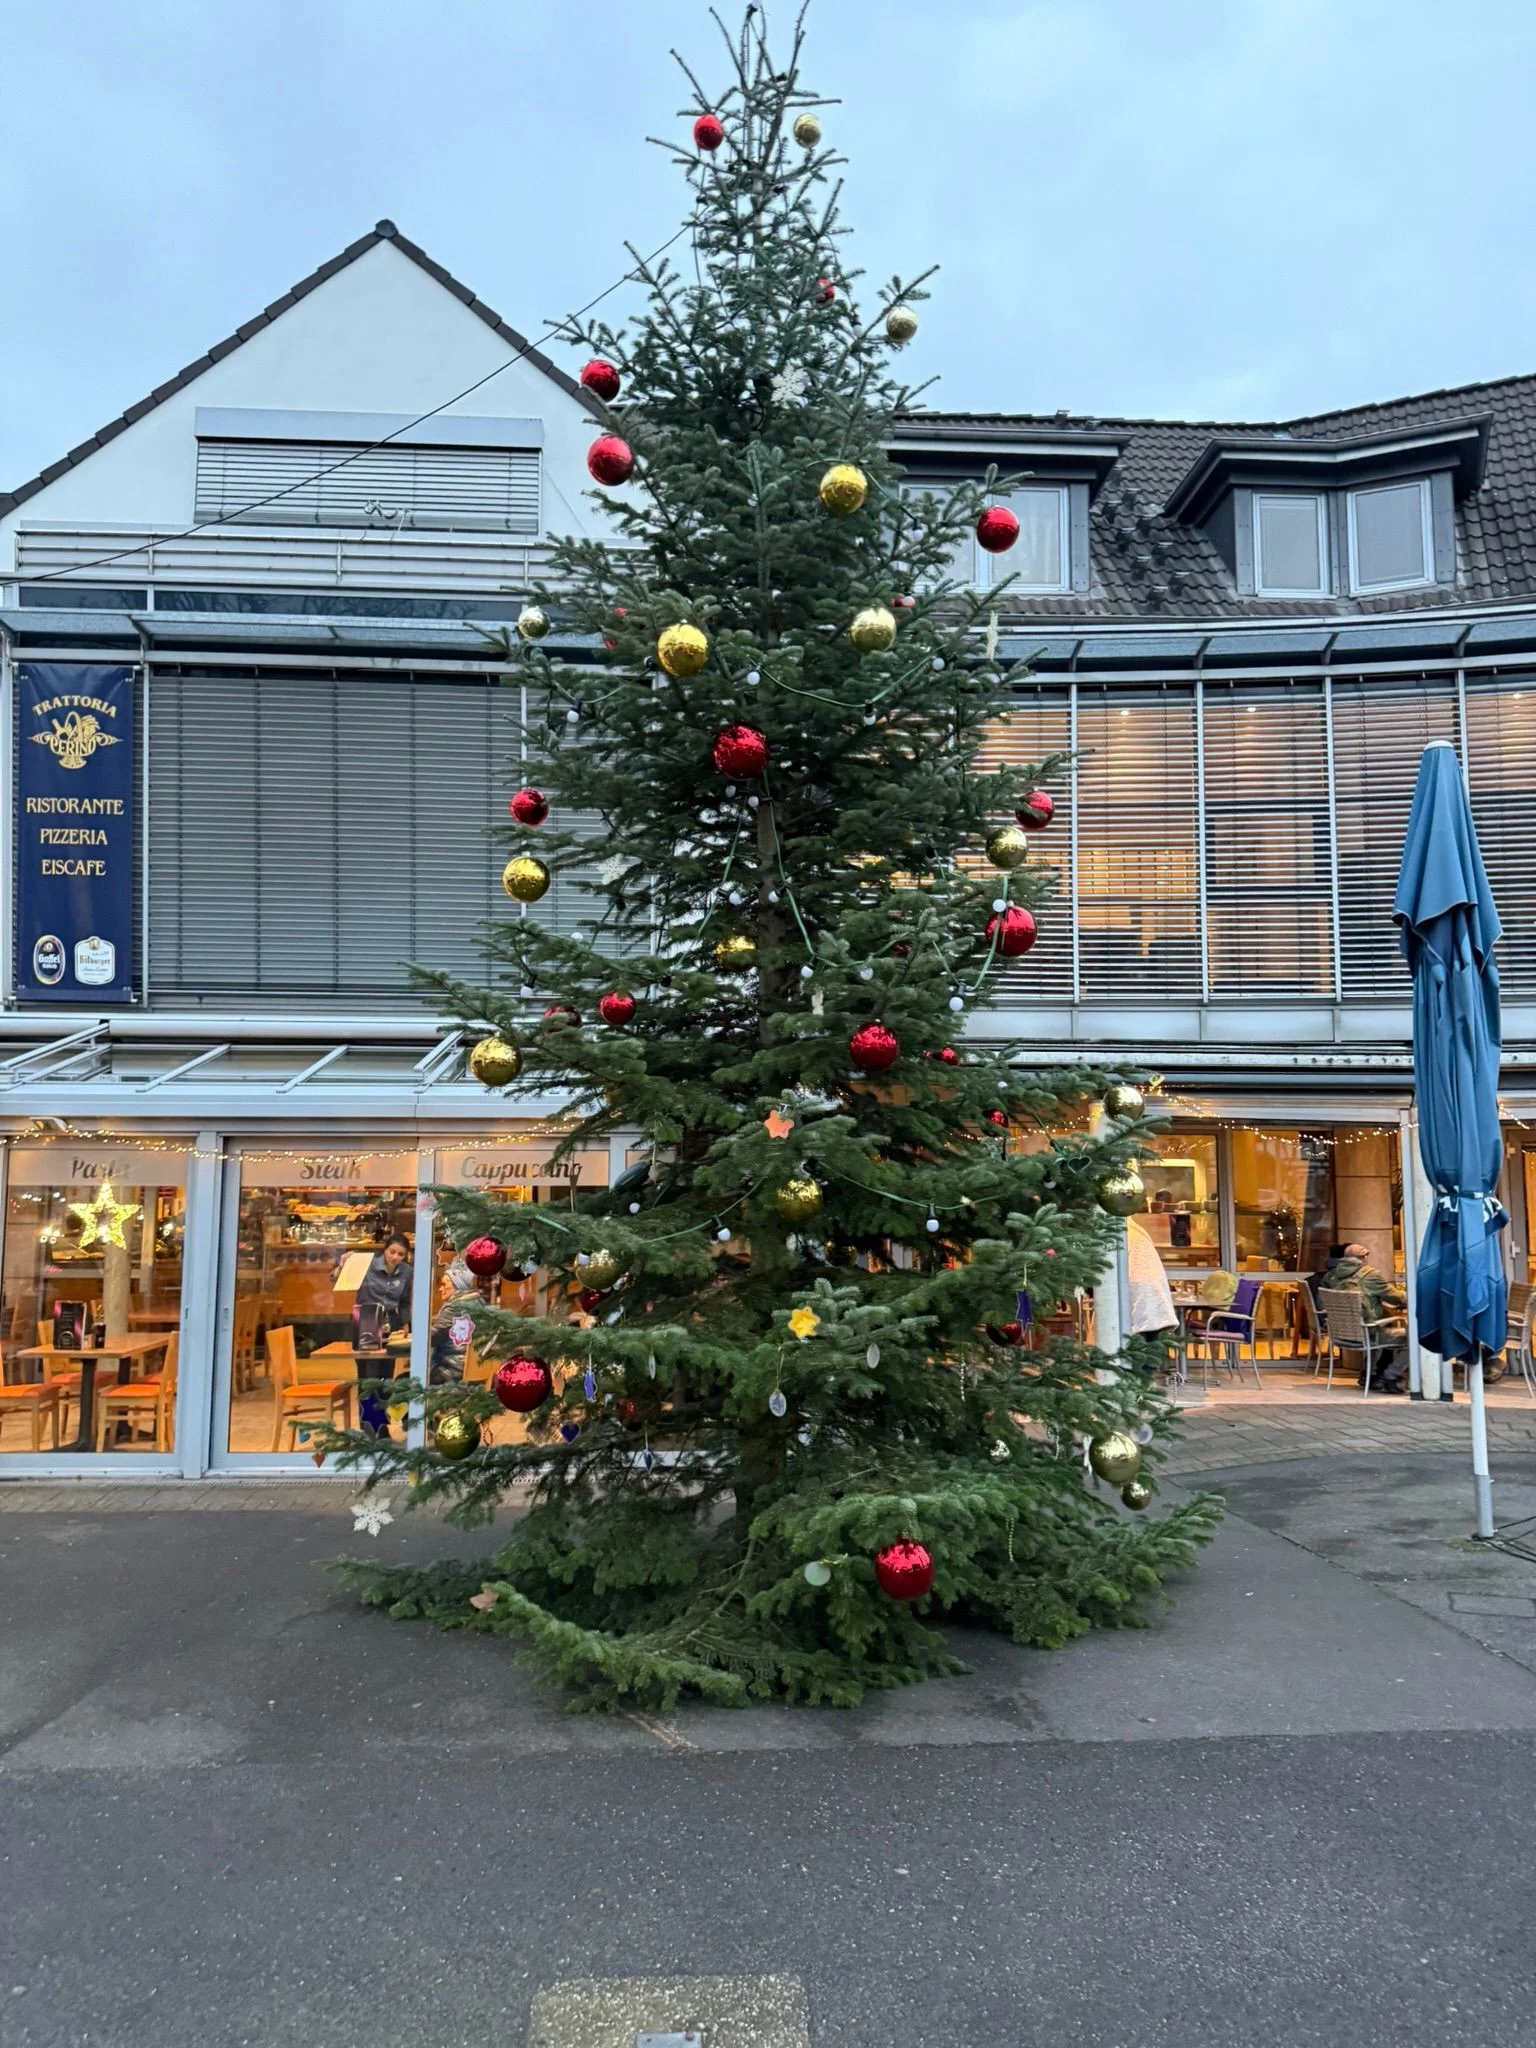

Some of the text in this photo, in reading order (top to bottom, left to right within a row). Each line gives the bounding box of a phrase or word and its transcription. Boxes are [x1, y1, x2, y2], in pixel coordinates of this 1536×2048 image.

[33, 695, 117, 718] TRATTORIA
[50, 736, 97, 757] PERINO
[26, 797, 124, 815] RISTORANTE
[40, 828, 108, 845] PIZZERIA
[42, 859, 106, 876] EISCAFE
[38, 953, 61, 964] Gaffel
[71, 1156, 130, 1179] Past
